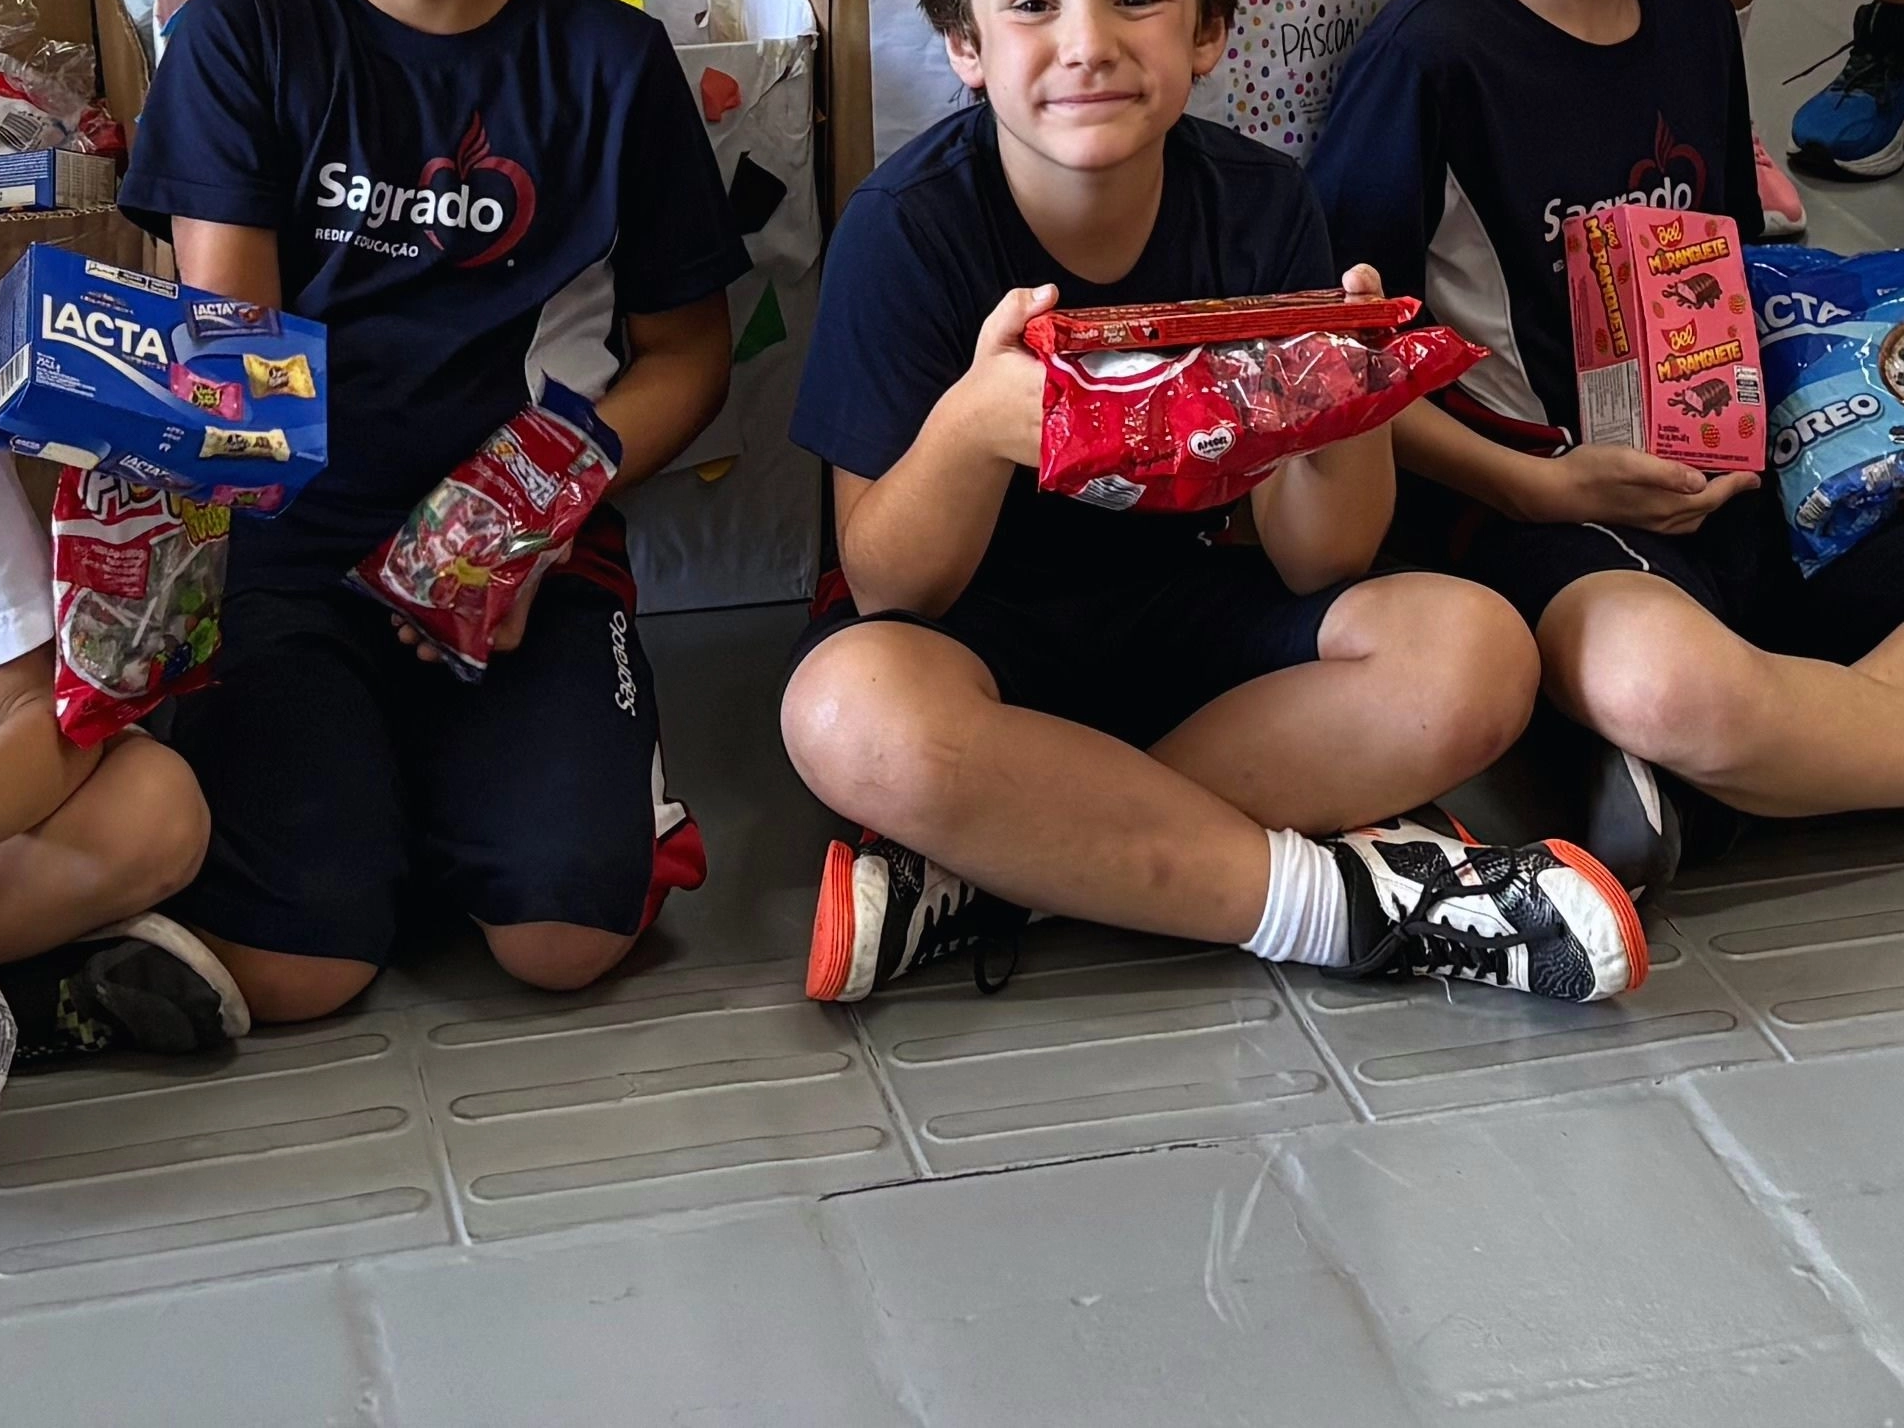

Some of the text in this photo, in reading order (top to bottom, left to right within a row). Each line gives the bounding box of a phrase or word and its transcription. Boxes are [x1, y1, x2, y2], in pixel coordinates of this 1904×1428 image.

[315, 161, 504, 234] Sagrado
[42, 294, 168, 364] LACTA
[1755, 293, 1851, 334] CTA
[1772, 394, 1880, 465] OREO
[610, 610, 636, 717] Sagrado
